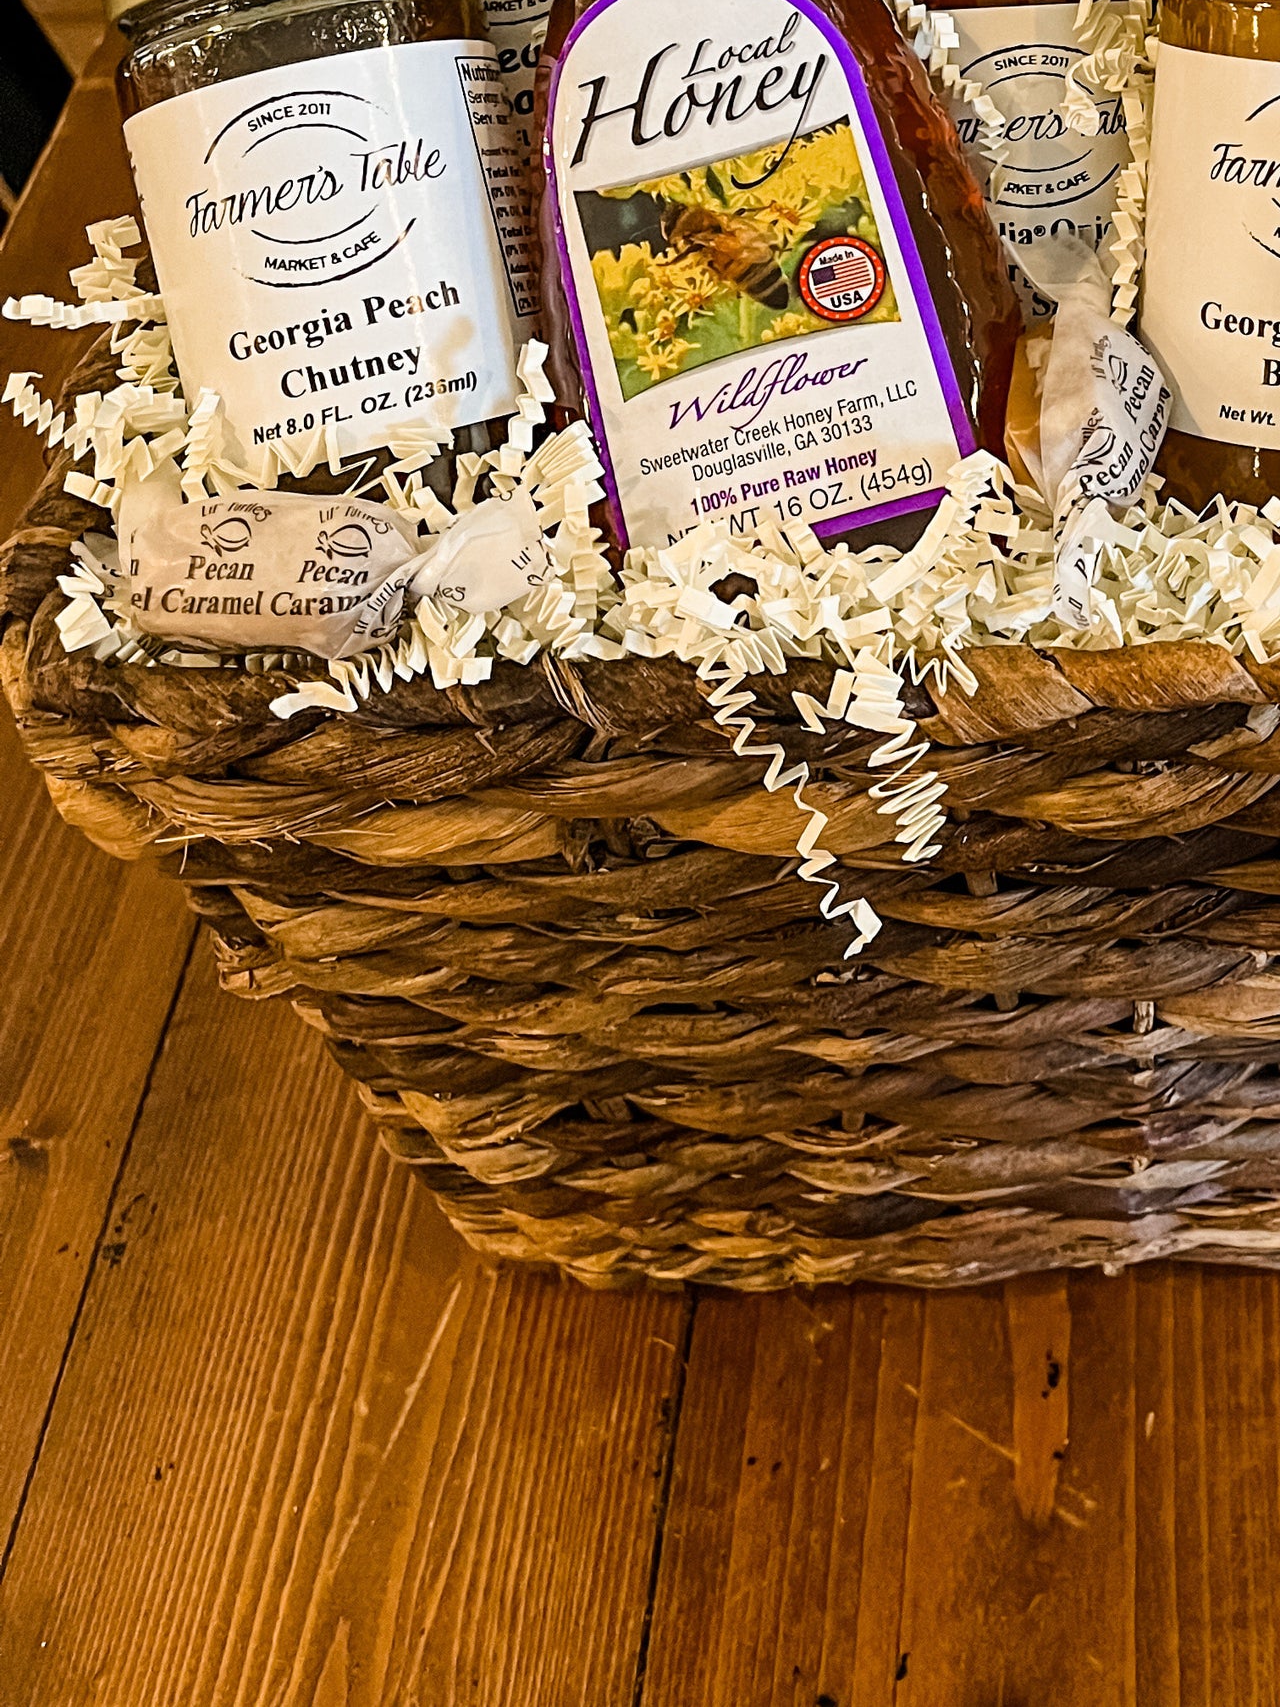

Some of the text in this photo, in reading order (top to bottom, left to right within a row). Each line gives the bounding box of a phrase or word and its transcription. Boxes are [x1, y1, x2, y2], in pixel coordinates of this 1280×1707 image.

[681, 11, 800, 83] Local
[994, 55, 1070, 71] SINCE 2011
[247, 103, 331, 133] SINCE 2011
[570, 42, 828, 189] Honey
[185, 138, 447, 239] Farmer's Table
[1057, 170, 1091, 192] CAFE
[263, 231, 381, 273] MARKET CAFE
[818, 249, 854, 266] Made In
[229, 280, 461, 362] Georgia Peach
[829, 290, 863, 308] USA
[280, 344, 422, 399] Chutney
[667, 352, 868, 431] Wildflower
[1124, 364, 1155, 424] Pecan
[253, 424, 282, 445] Net
[286, 413, 315, 436] 8.0
[321, 405, 353, 427] FL.
[361, 392, 398, 415] OZ.
[639, 380, 918, 476] Sweetwater Creek Honey Farm, LLC
[1219, 405, 1246, 423] Net
[1250, 410, 1276, 427] Wt.
[692, 415, 873, 481] Douglasville, GA 30133
[1079, 441, 1134, 495] Pecan
[690, 447, 878, 516] 100% Pure Raw Honey
[774, 458, 933, 522] 16 OZ. (454g)
[185, 555, 254, 581] Pecan
[297, 560, 370, 586] Pecan
[160, 587, 263, 615] Caramel
